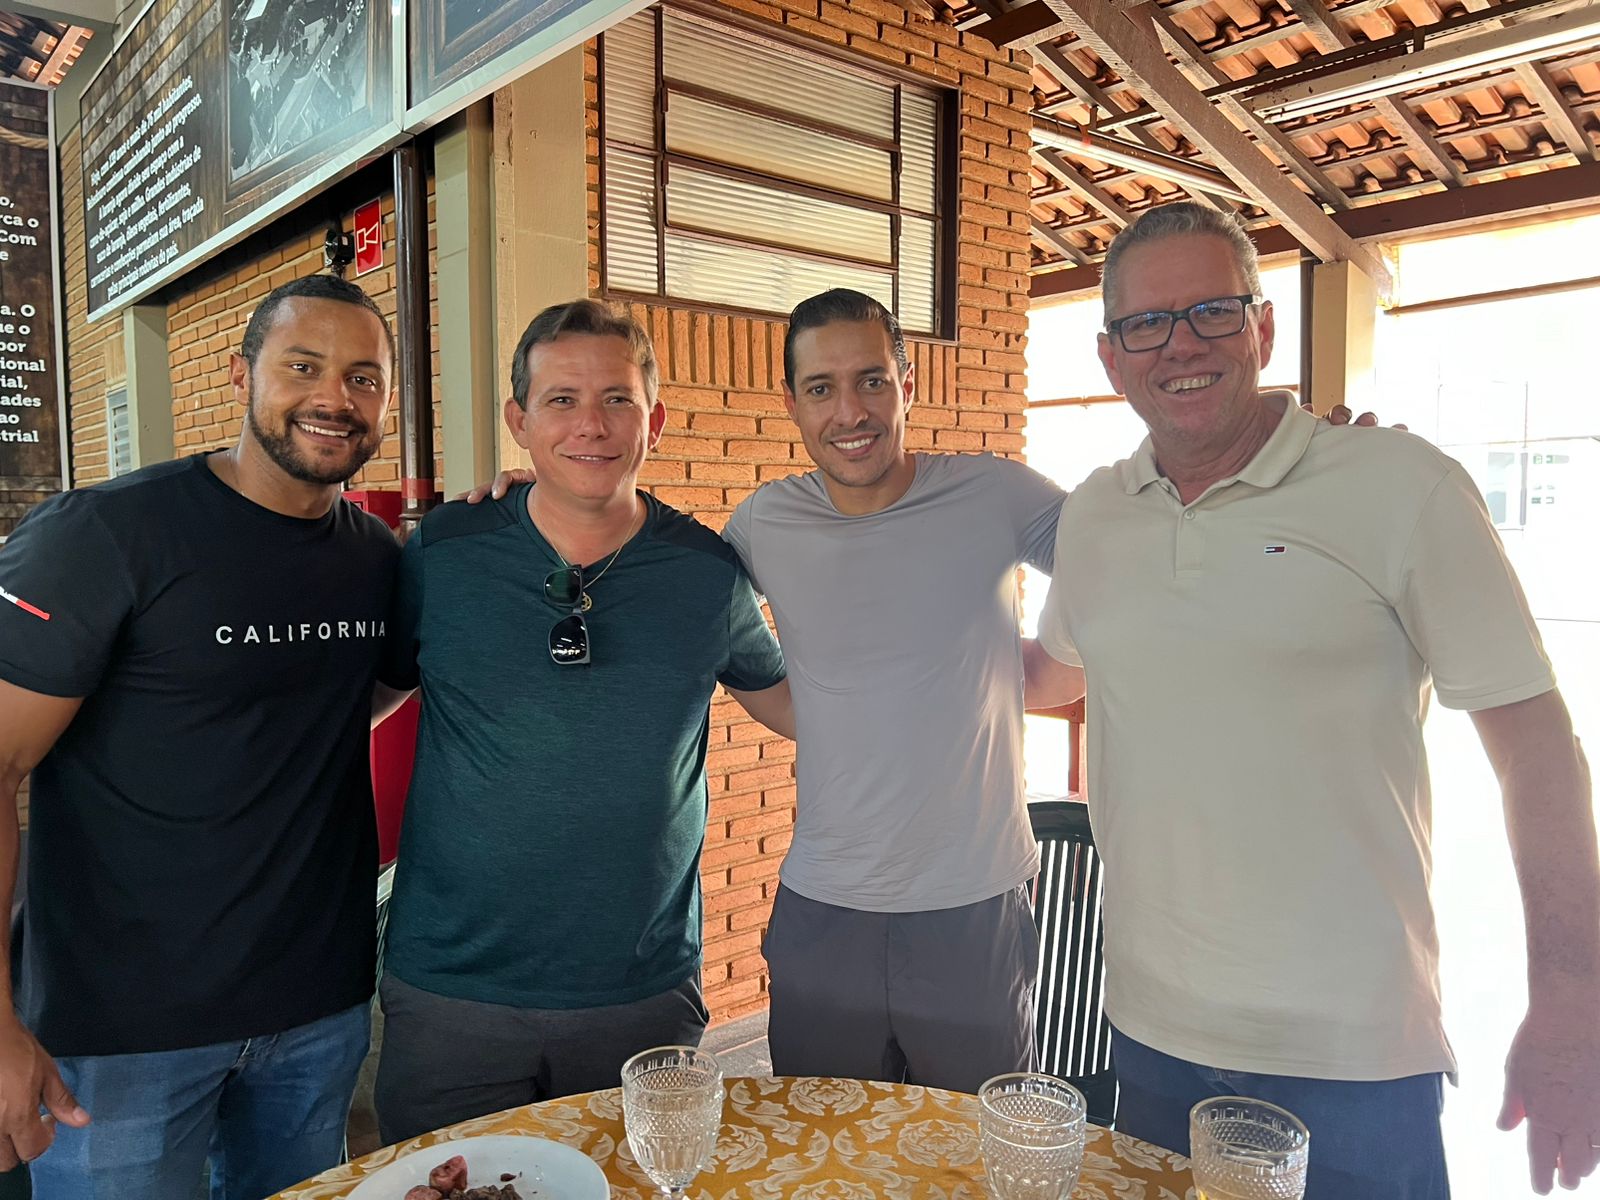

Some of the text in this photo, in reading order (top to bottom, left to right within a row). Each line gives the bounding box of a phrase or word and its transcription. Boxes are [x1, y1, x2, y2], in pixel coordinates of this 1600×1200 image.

[116, 142, 127, 161] anos
[129, 125, 141, 147] mais
[153, 101, 163, 123] mil
[161, 75, 193, 114] habitantes,
[123, 139, 151, 176] caminhando
[150, 128, 165, 154] junto
[172, 93, 202, 134] progresso.
[115, 187, 128, 208] agora
[127, 172, 142, 195] divide
[141, 166, 151, 183] seu
[167, 139, 180, 159] com
[145, 177, 166, 203] Grandes
[165, 154, 194, 186] indústrias
[193, 145, 202, 163] de
[158, 183, 191, 217] fertilizantes,
[27, 218, 40, 229] o
[158, 224, 169, 241] sua
[182, 196, 205, 224] traçada
[158, 249, 167, 265] do
[20, 304, 36, 318] O
[18, 324, 31, 335] o
[215, 620, 386, 645] CALIFORNIA
